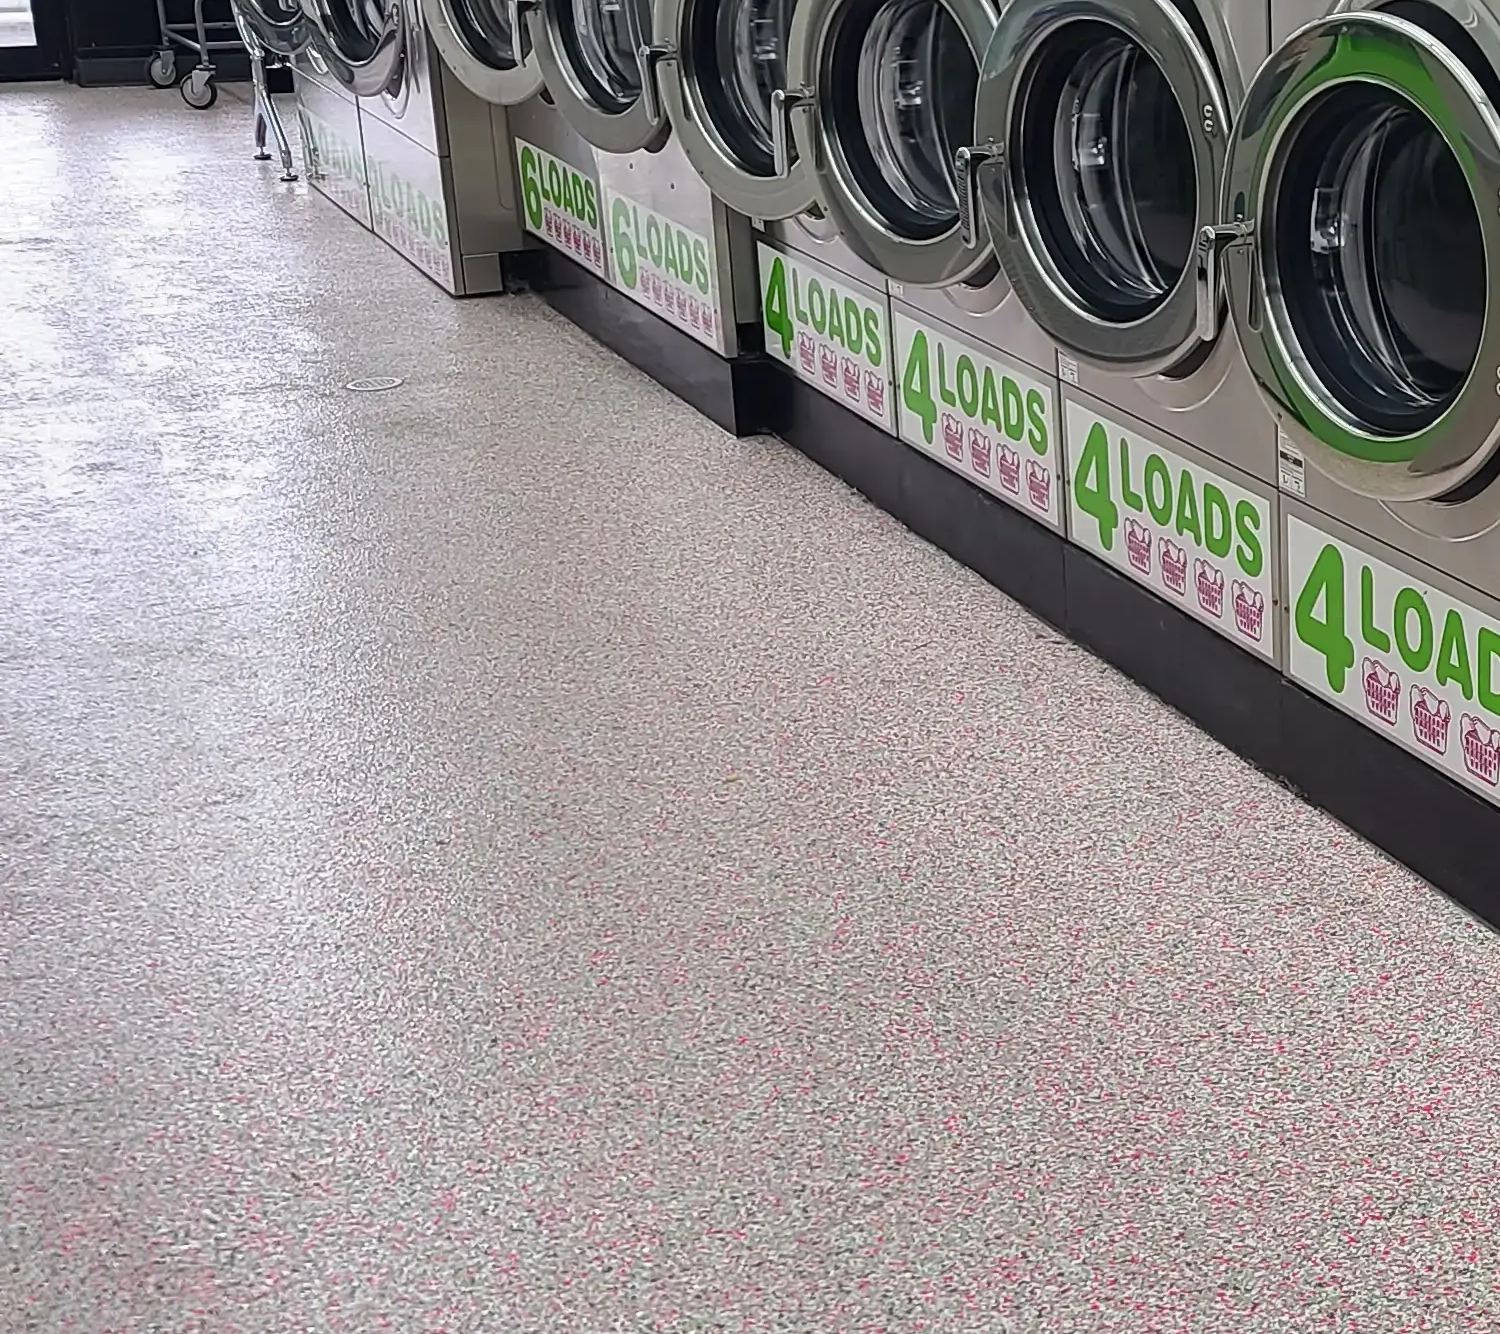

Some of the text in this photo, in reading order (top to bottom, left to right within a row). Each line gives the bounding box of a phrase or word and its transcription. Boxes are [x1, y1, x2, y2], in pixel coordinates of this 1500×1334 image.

[521, 145, 598, 231] 6 LOADS
[612, 197, 709, 295] 6 LOADS
[765, 255, 883, 368] 4 LOADS
[902, 329, 1049, 457] 4 LOADS
[1073, 421, 1119, 552] 4
[1118, 437, 1264, 579] LOADS
[1294, 543, 1356, 695] 4
